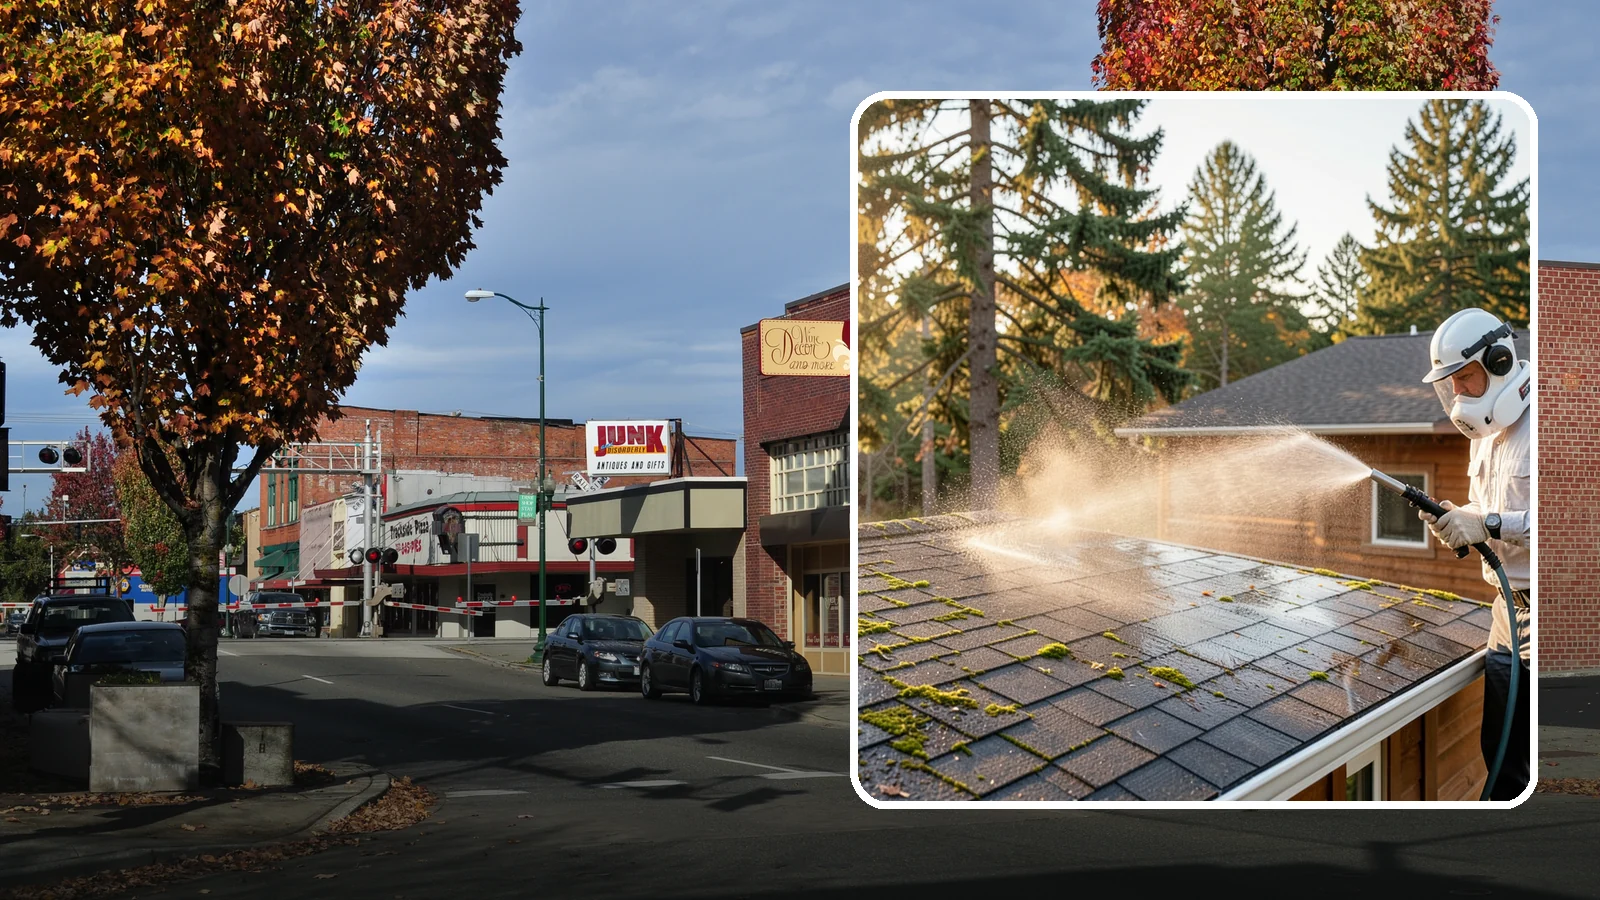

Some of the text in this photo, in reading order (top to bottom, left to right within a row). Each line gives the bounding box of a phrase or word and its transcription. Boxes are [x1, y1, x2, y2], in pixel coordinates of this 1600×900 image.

[595, 425, 665, 457] JUNK
[607, 446, 645, 454] DISORDERLY
[597, 460, 665, 470] ANTIQUES AND GIFTS
[414, 519, 429, 535] Pizza
